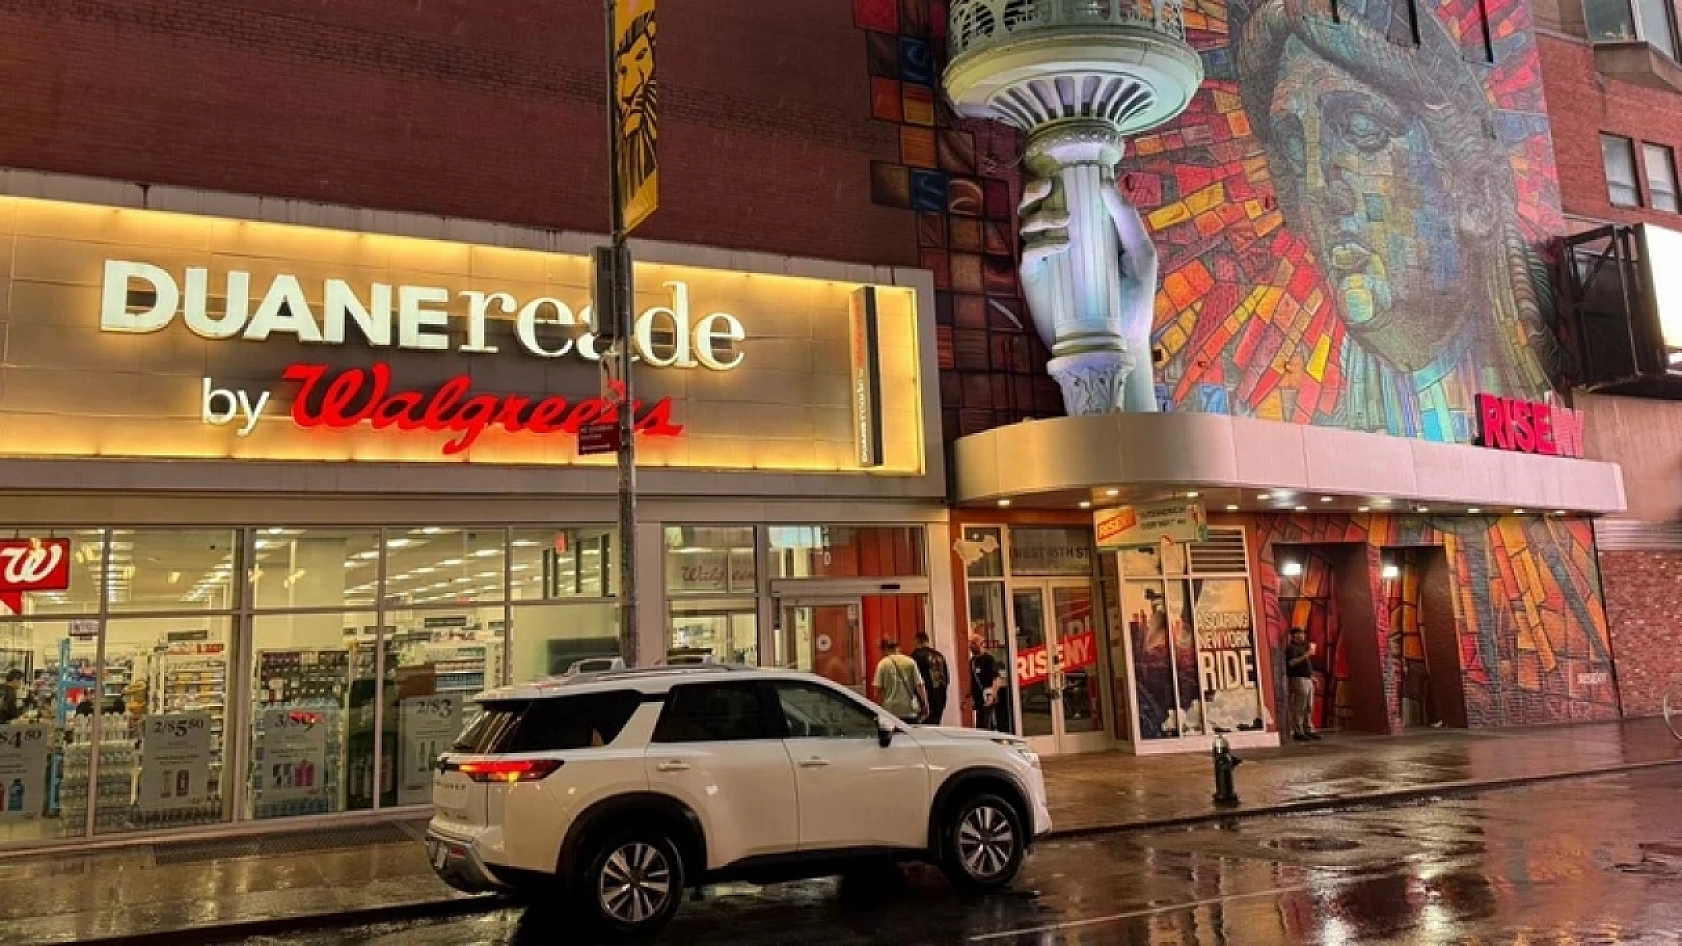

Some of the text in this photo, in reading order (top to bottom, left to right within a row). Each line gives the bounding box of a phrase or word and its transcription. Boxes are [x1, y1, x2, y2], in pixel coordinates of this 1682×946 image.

[101, 259, 449, 351] DUANE
[202, 377, 270, 437] by
[1198, 650, 1254, 690] RIDE
